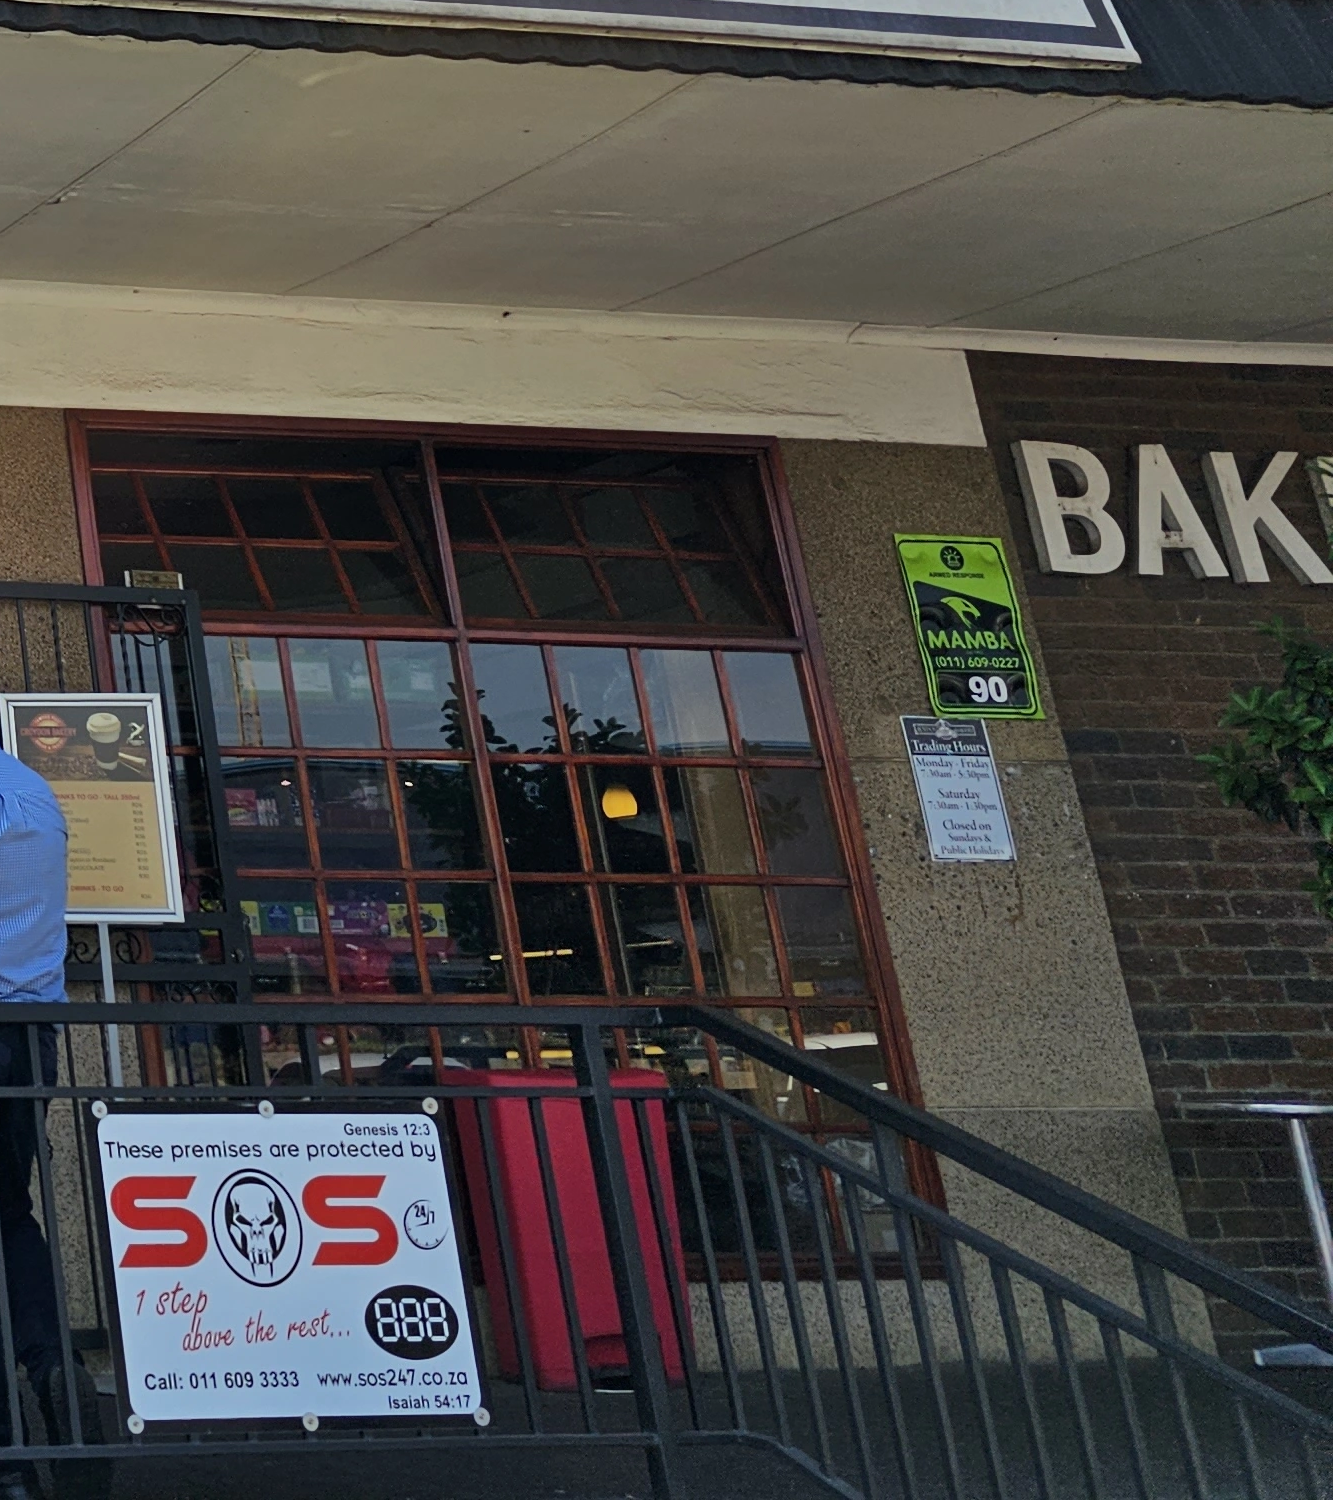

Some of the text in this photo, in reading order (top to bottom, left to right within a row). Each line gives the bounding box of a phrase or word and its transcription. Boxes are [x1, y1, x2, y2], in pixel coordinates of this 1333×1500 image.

[1010, 439, 1333, 586] BAK
[927, 630, 1015, 650] MAMBA
[935, 657, 1019, 668] (011) 609-0227
[968, 676, 1008, 703] 90
[911, 739, 986, 752] Trading Hours
[916, 757, 953, 769] Monday
[960, 757, 989, 770] Friday
[938, 788, 980, 801] Saturday
[943, 819, 992, 831] Closed on
[948, 832, 983, 843] Sundays
[941, 845, 1005, 856] Public Holidays
[343, 1123, 430, 1136] Genesis 12:3
[104, 1142, 436, 1162] These premises are protected by
[136, 1281, 208, 1332] 1 step
[374, 1298, 449, 1342] 888
[183, 1317, 235, 1351] above
[245, 1310, 277, 1344] the
[145, 1371, 300, 1390] Call: 011 609 3333
[317, 1368, 468, 1387] www.sos247.co.za
[388, 1394, 470, 1409] Isaiah 54:17
